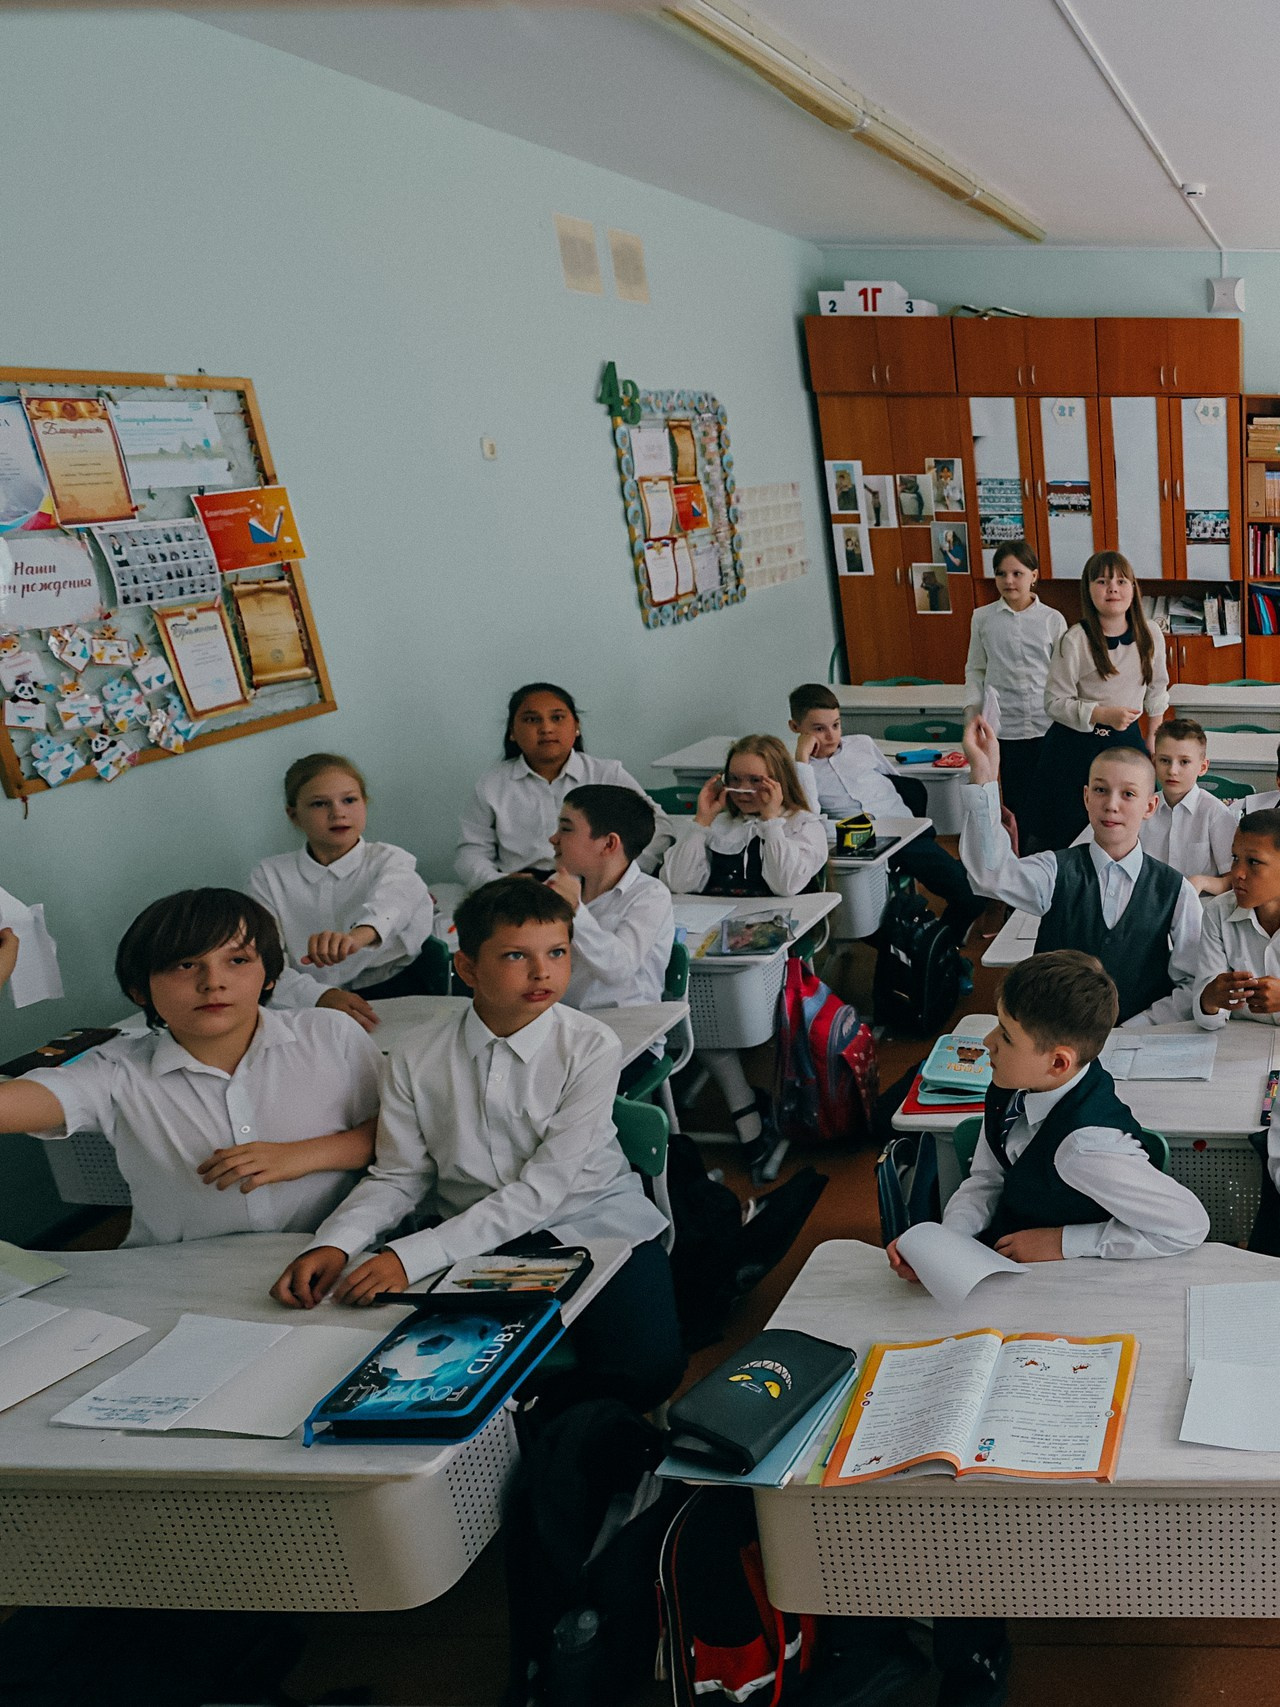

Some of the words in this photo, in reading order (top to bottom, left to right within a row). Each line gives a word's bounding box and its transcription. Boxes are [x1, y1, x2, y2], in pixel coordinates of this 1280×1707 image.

[828, 300, 837, 313] 2
[905, 301, 914, 313] 3
[14, 561, 56, 576] Наши
[21, 577, 92, 598] рождения
[466, 1332, 514, 1375] CLUB
[344, 1384, 469, 1402] FOOTBALL
